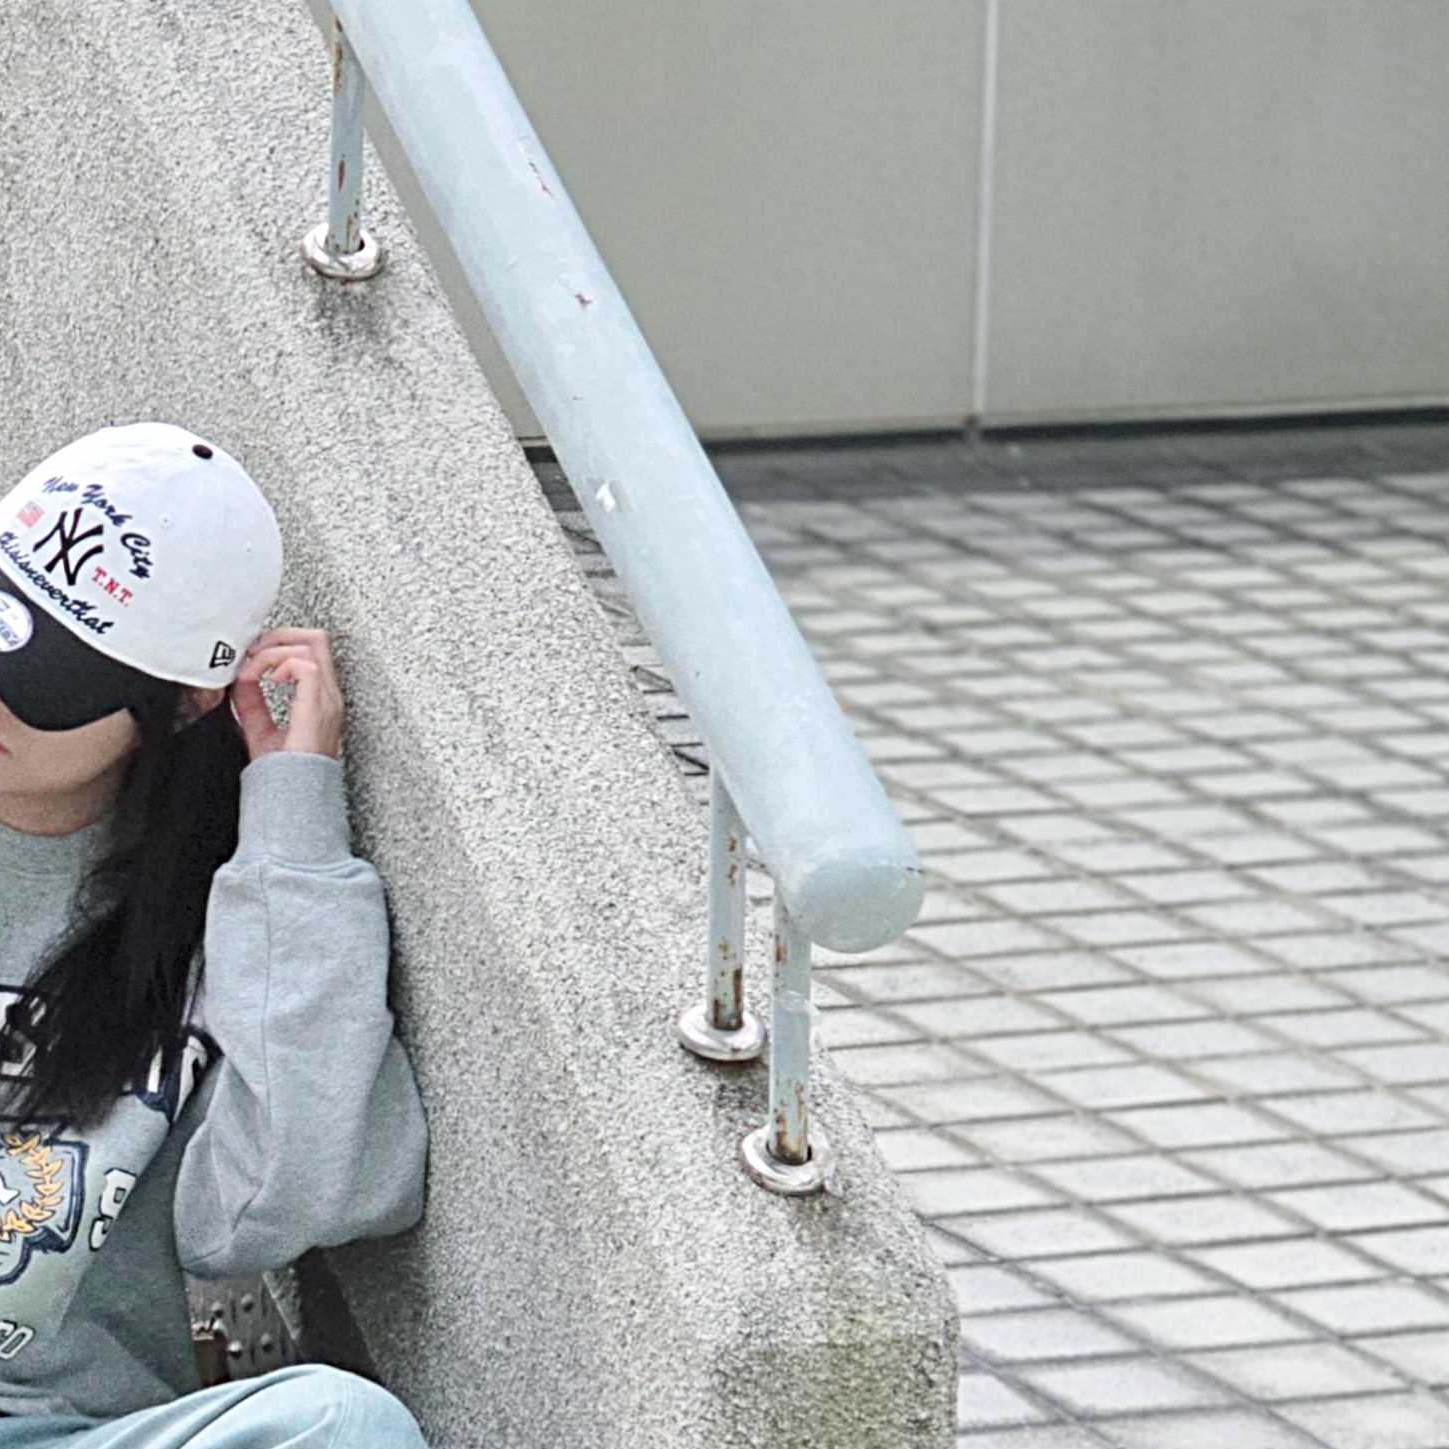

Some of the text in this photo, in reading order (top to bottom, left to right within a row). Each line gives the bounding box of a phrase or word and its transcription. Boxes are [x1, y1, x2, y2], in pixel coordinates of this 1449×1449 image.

[32, 506, 105, 587] NY
[41, 475, 154, 580] New York City
[91, 566, 134, 608] T.N.T.
